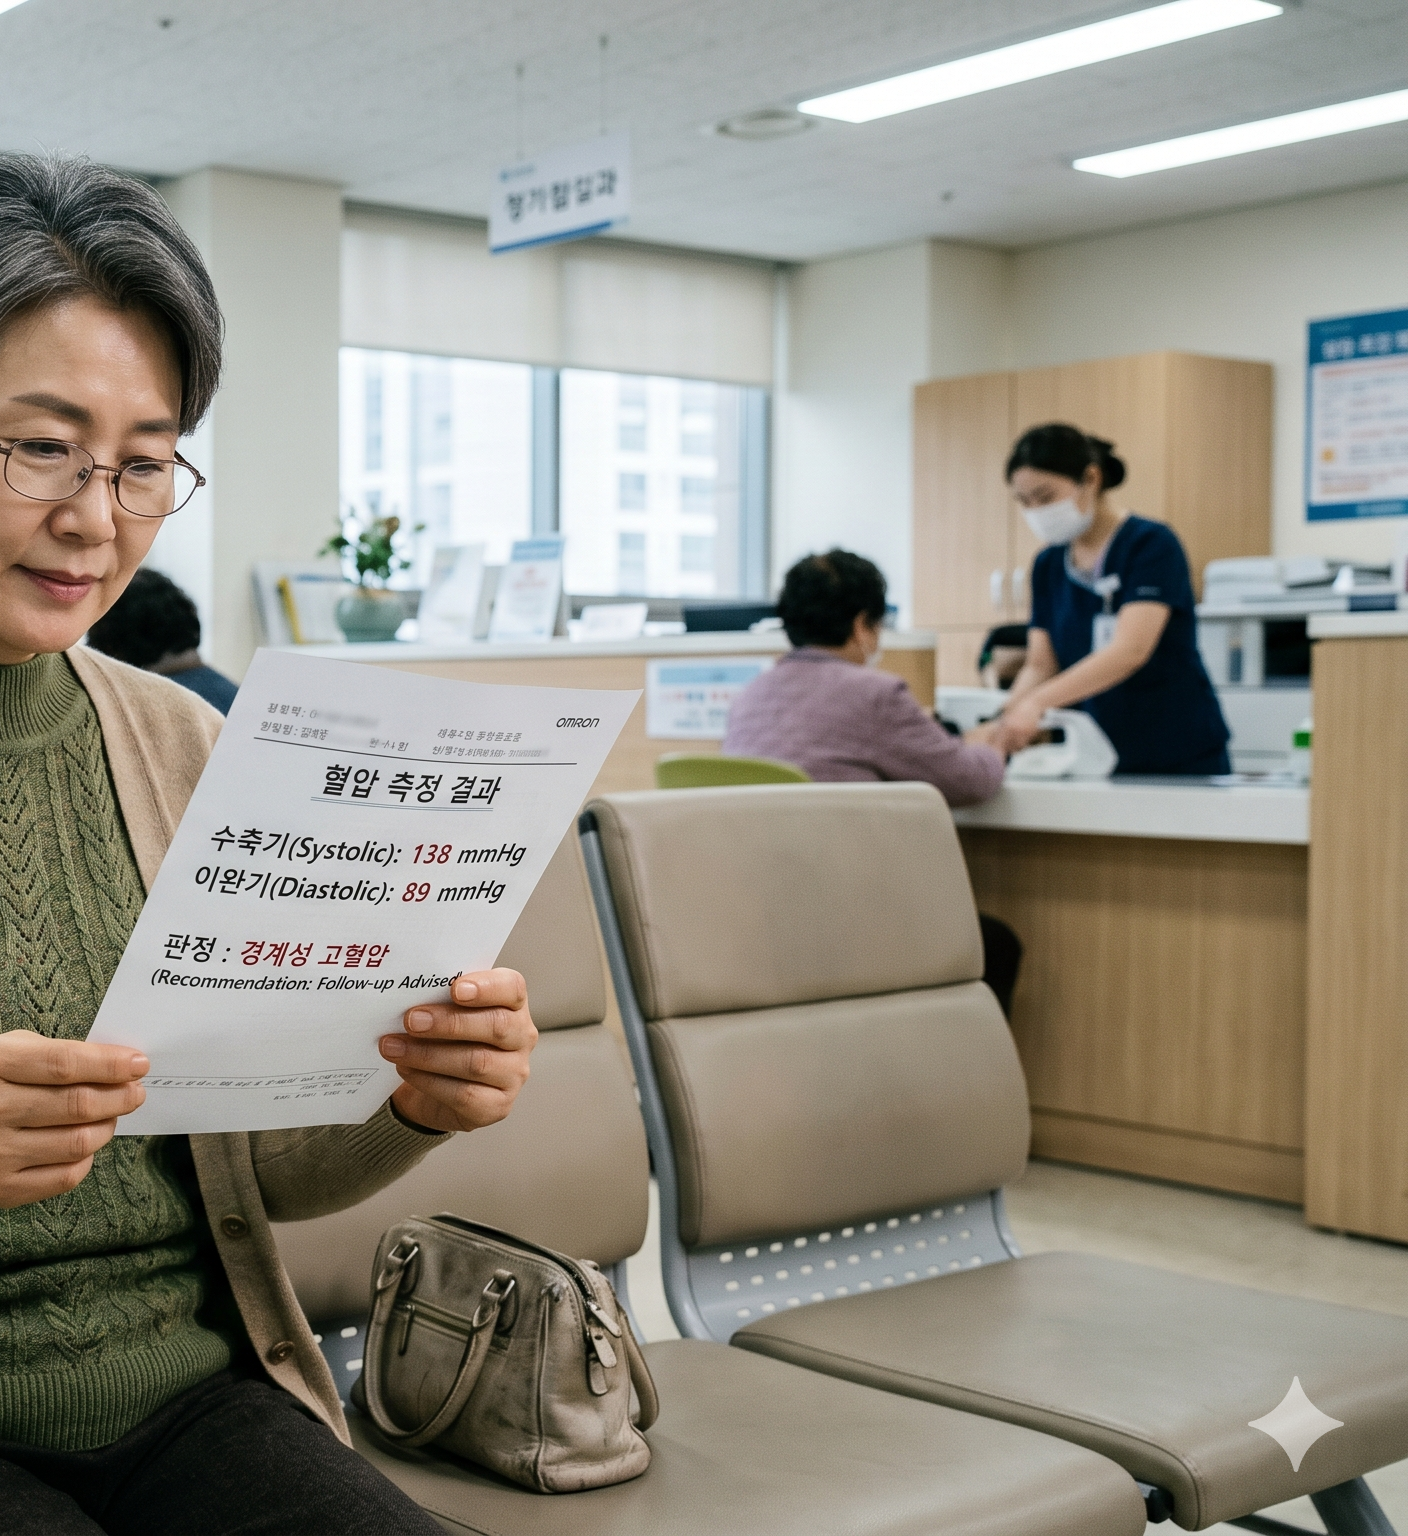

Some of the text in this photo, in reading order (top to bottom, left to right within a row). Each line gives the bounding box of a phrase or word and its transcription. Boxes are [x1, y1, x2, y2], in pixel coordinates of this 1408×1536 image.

[556, 717, 600, 728] OMRON
[322, 764, 502, 805] 혈압 측정 결과
[210, 825, 527, 868] 수축기(Systolic): 138 mmHg
[194, 865, 506, 906] 이완기(Diastolic): 89 mmHg
[163, 933, 217, 963] 판정
[240, 940, 314, 968] 경계성
[317, 943, 390, 968] 고혈압
[150, 968, 463, 993] (Recommendation: Follow-up Advised
